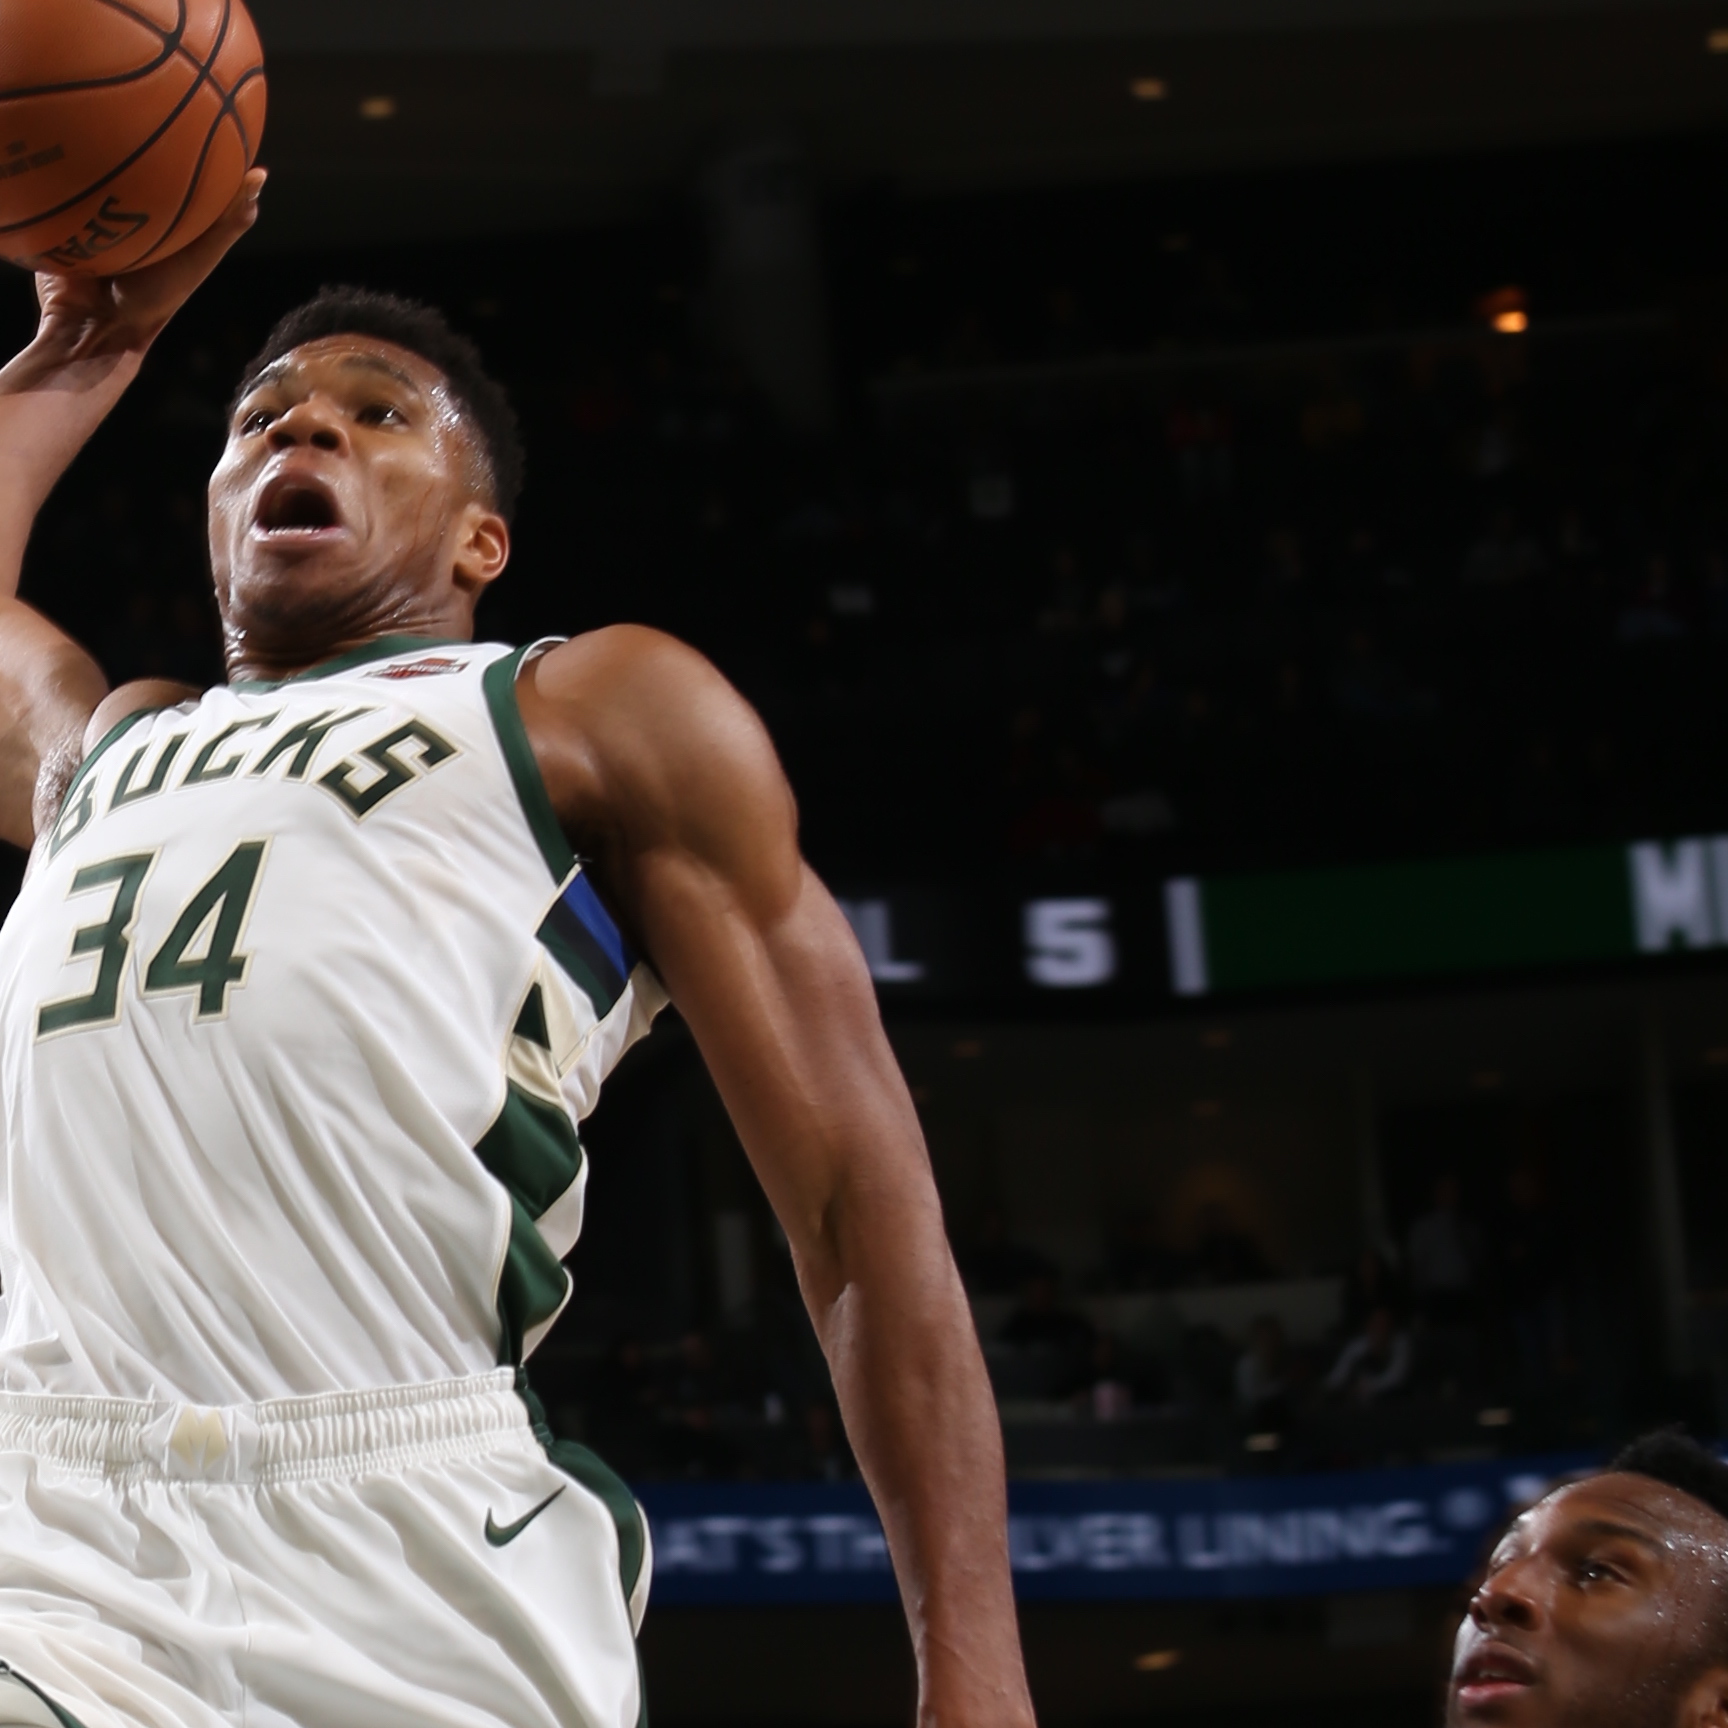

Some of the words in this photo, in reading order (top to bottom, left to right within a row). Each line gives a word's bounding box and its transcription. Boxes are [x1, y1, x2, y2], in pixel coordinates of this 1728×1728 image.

[46, 704, 461, 867] BUCKS
[33, 833, 276, 1045] 34
[1024, 897, 1113, 987] 5
